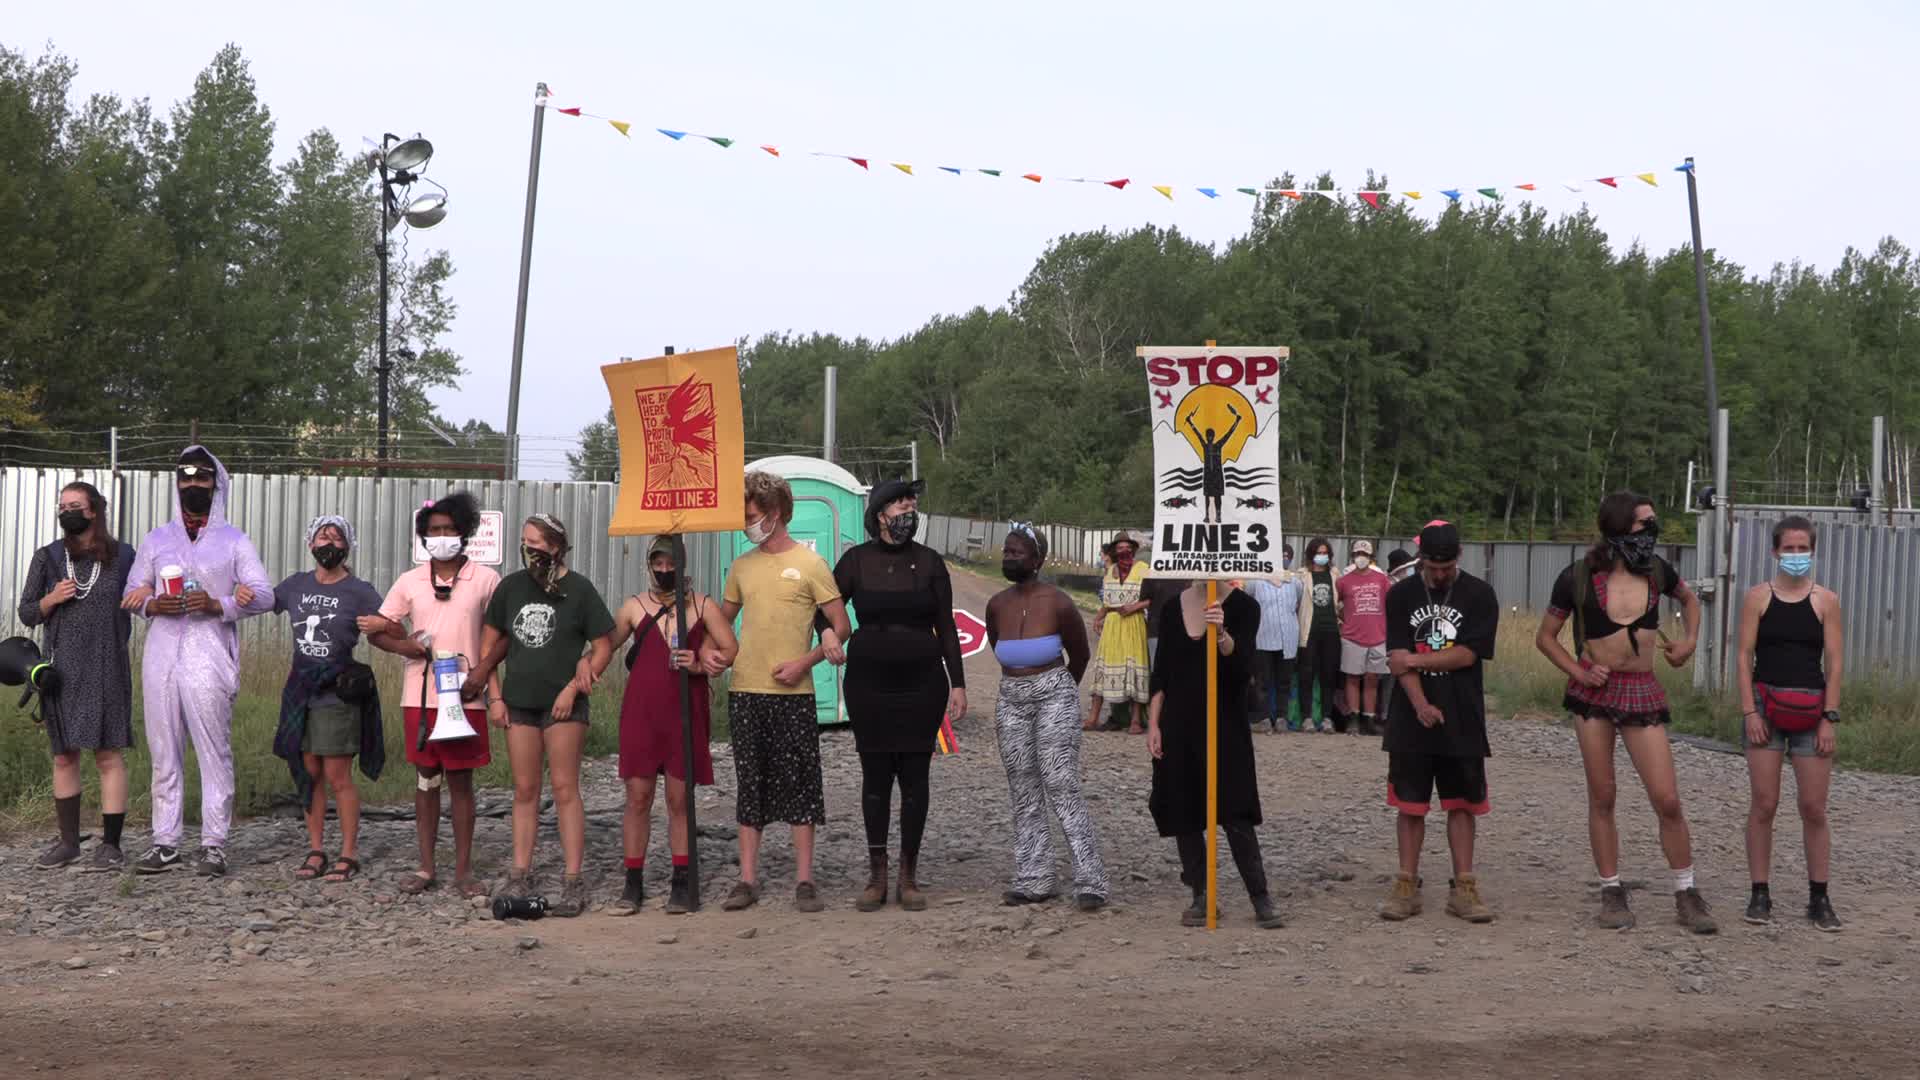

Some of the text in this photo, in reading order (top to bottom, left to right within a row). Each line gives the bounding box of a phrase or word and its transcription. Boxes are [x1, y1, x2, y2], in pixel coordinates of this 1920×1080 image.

[1147, 356, 1279, 386] STOP
[639, 393, 655, 404] WE
[643, 404, 665, 416] HERE
[645, 417, 657, 428] TO
[675, 491, 704, 507] LINE
[706, 490, 716, 505] 3
[1162, 523, 1270, 552] LINE 3
[1172, 552, 1190, 560] TAR
[1190, 553, 1219, 561] SANDS
[1153, 560, 1274, 573] CLIMATE CRISIS
[302, 593, 339, 608] WATER
